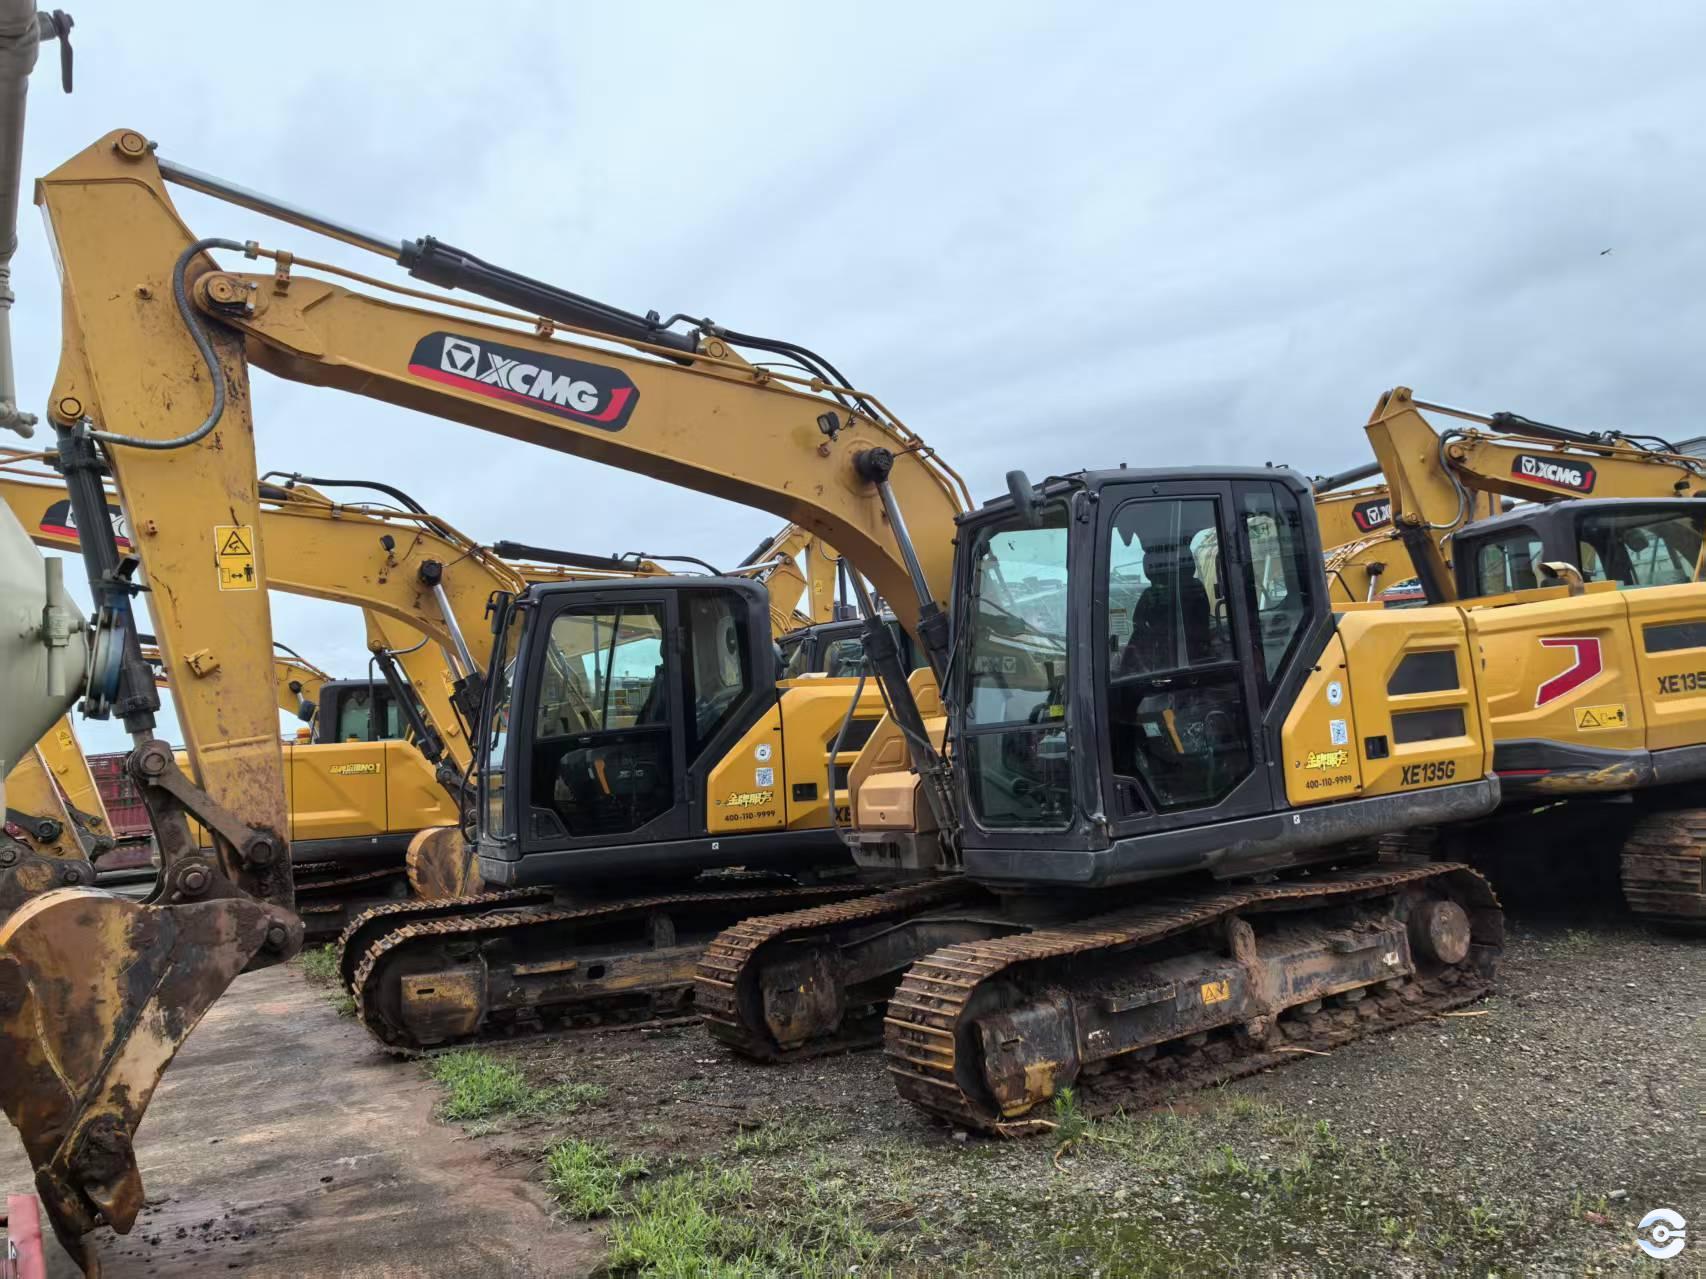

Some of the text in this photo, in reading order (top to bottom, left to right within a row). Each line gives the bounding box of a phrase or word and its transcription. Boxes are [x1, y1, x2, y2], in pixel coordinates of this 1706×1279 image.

[476, 352, 599, 412] XCMG
[1537, 461, 1582, 486] XCMG
[1305, 775, 1352, 789] 400-110-9999
[1401, 760, 1456, 786] XE135G
[725, 810, 776, 821] 400-110-9999
